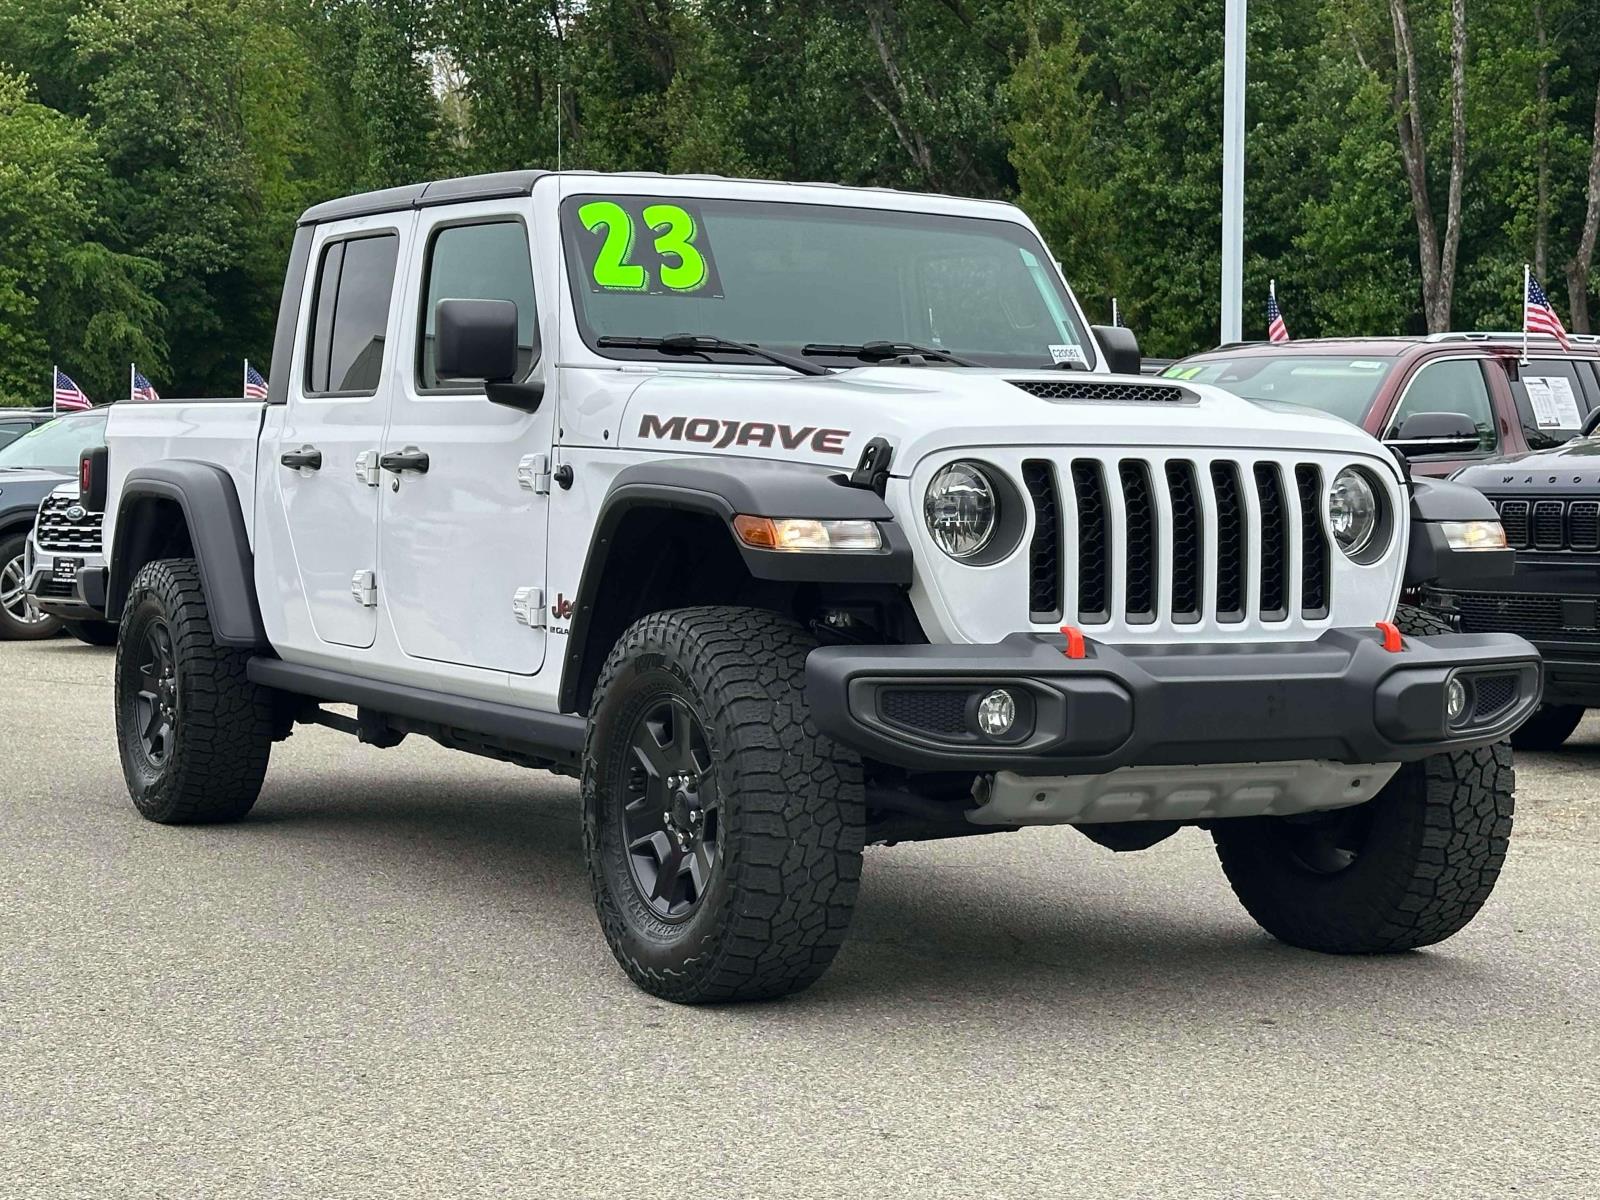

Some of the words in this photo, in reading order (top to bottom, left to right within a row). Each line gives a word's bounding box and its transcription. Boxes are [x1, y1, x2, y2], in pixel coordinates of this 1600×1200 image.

[578, 201, 708, 292] 23
[638, 414, 851, 455] MOJAVE
[1502, 476, 1600, 484] WAGO
[551, 592, 576, 620] Je
